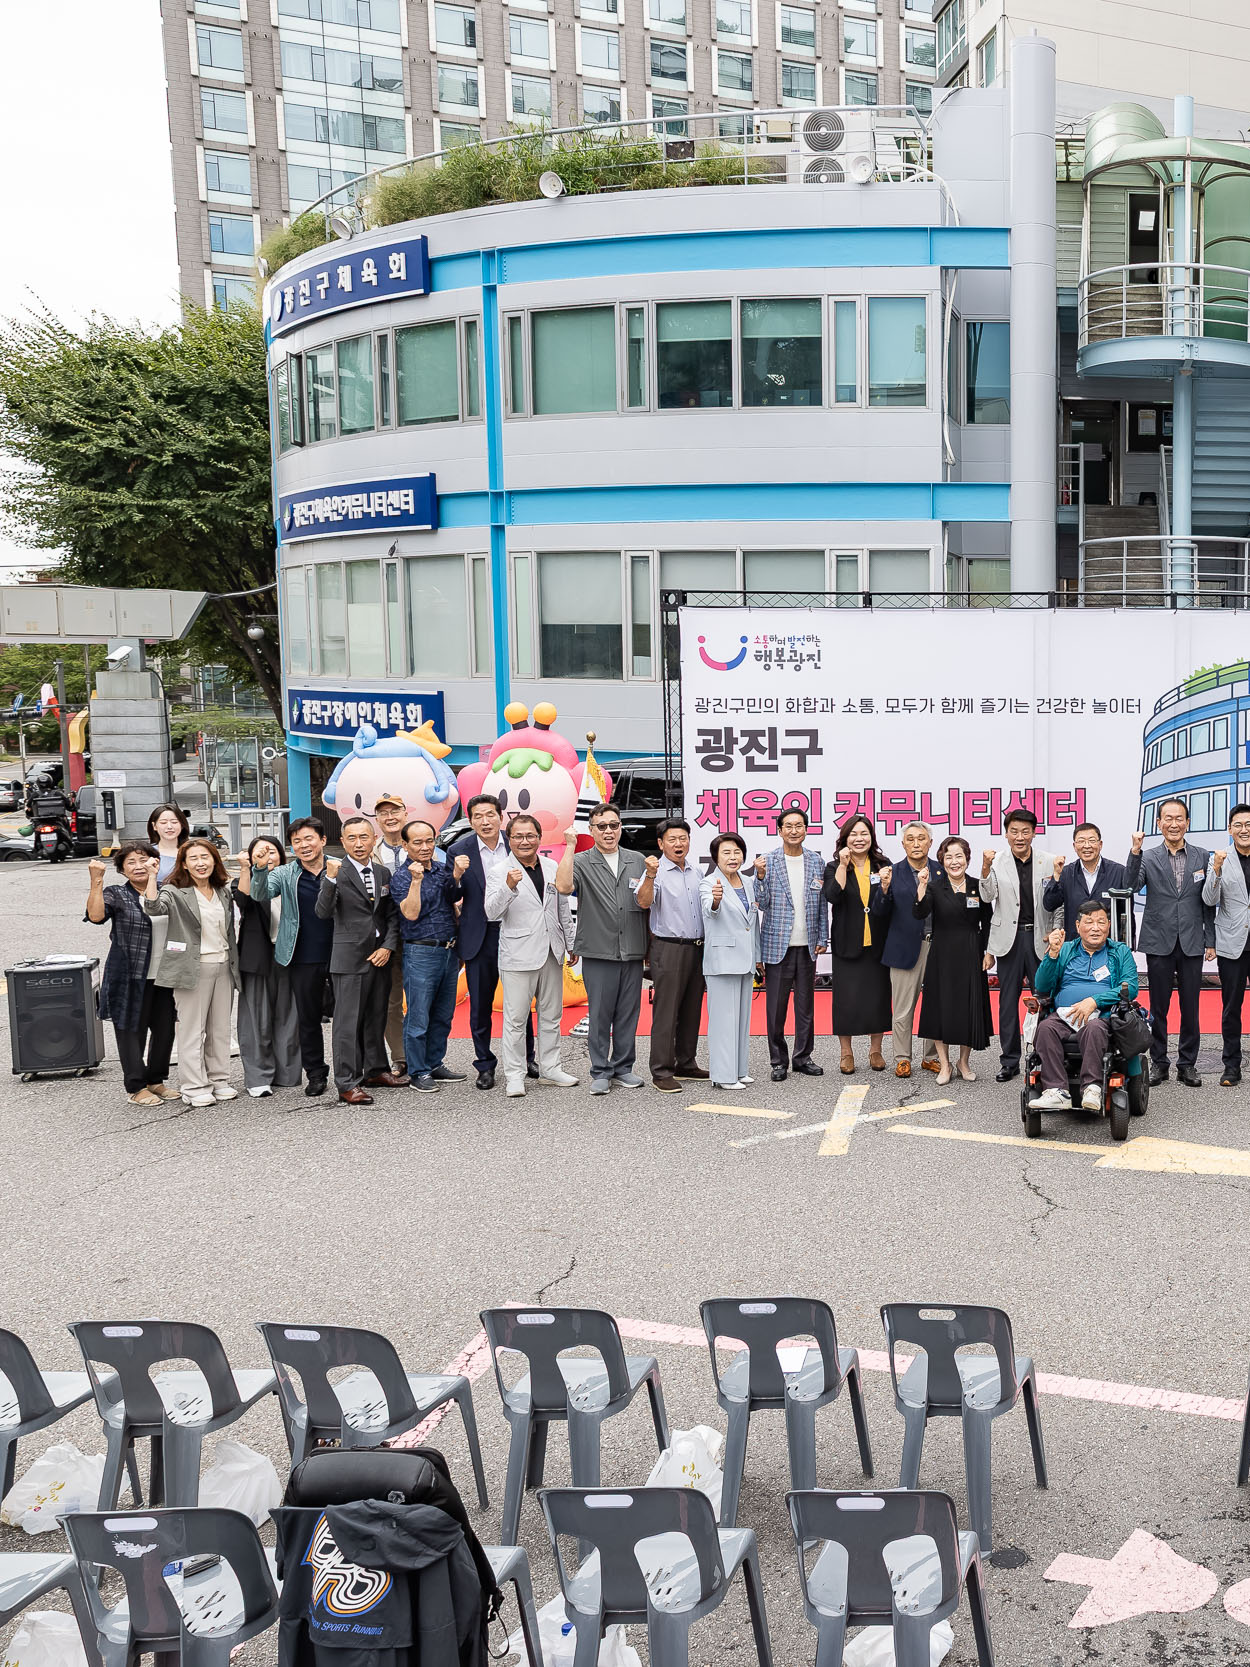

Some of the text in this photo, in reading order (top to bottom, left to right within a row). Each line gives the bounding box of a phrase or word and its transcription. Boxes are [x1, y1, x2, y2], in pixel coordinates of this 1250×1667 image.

[284, 252, 406, 313] 광진구체육회
[293, 489, 415, 528] 광진구체육인커뮤니티센터
[753, 634, 821, 649] 소통하며 발전하는
[753, 647, 822, 672] 행복광진
[301, 699, 423, 730] 광진구장애인체육회
[694, 697, 1142, 715] 광진구민의 화합과 소통, 모두가 함께 즐기는 건강한 놀이터
[695, 726, 823, 773] 광진구
[695, 787, 1087, 836] 체육인 커뮤니티센터
[25, 977, 73, 986] SECO
[321, 1622, 351, 1632] SPORTS
[351, 1624, 384, 1635] RUNNING
